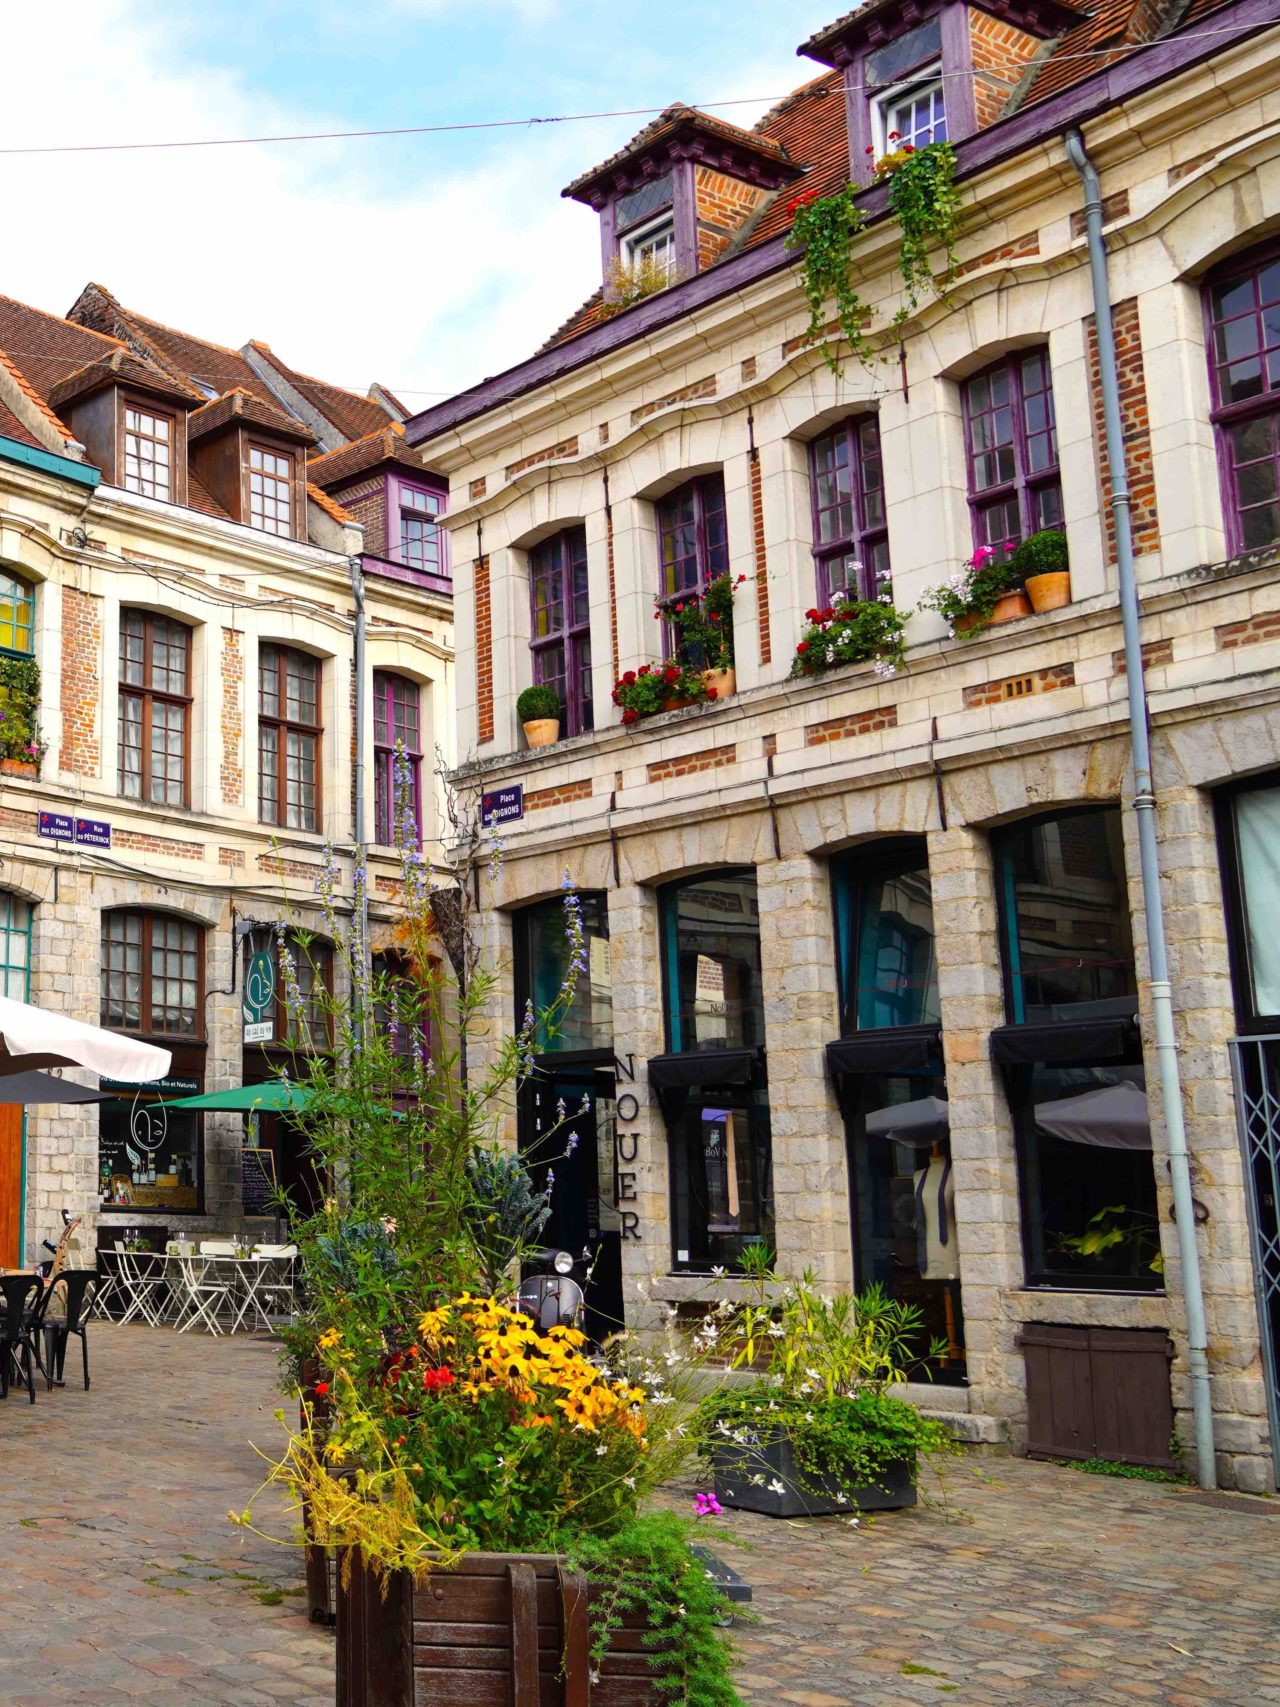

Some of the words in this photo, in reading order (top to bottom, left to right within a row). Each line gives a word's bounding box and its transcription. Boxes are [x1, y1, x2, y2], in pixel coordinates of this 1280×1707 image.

[500, 794, 515, 803] Place
[56, 818, 68, 826] Place
[50, 828, 71, 837] OIGNONS
[614, 1053, 642, 1239] NOUER
